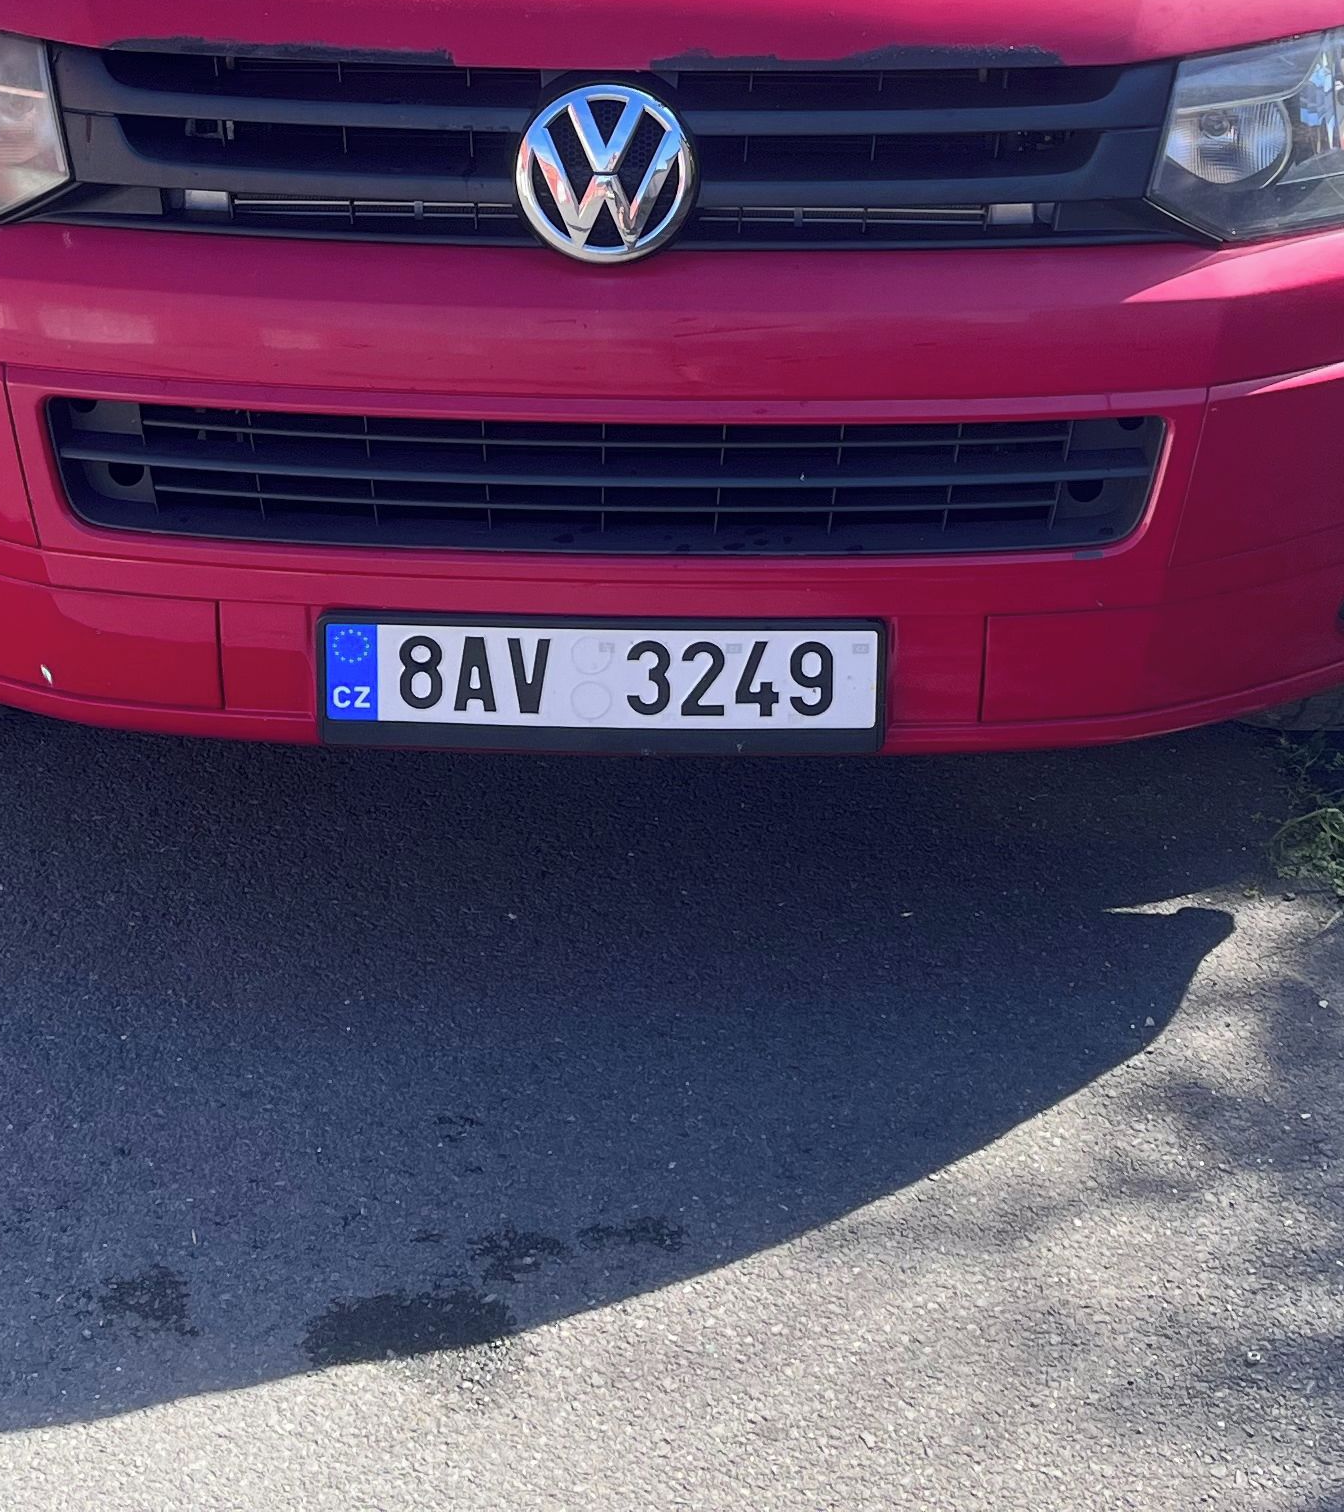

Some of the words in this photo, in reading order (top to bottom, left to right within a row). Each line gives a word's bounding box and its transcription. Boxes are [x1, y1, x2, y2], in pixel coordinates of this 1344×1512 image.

[332, 685, 371, 709] CZ
[399, 635, 551, 714] 8AV
[627, 640, 834, 717] 3249
